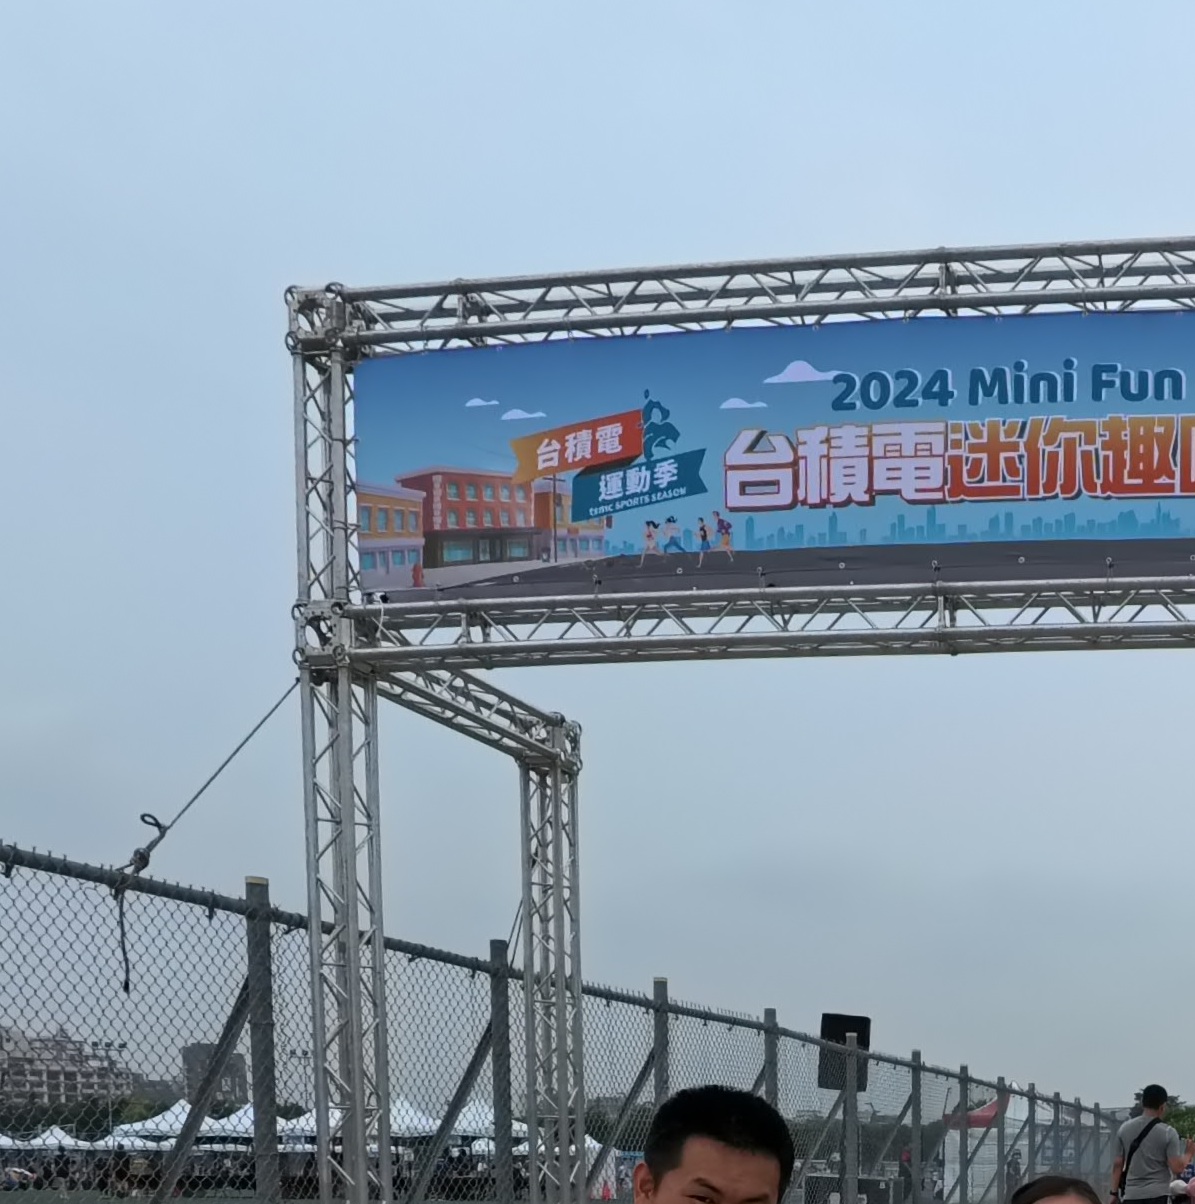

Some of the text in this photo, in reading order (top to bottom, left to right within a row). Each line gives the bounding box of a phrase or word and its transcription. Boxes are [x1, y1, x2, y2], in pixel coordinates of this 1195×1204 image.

[831, 368, 954, 411] 2024
[969, 357, 1078, 405] Mini
[1091, 361, 1185, 402] Fun
[536, 422, 623, 470] 台積電
[598, 458, 678, 501] 運動季
[615, 494, 650, 510] SPORTS
[651, 486, 687, 502] SEASON
